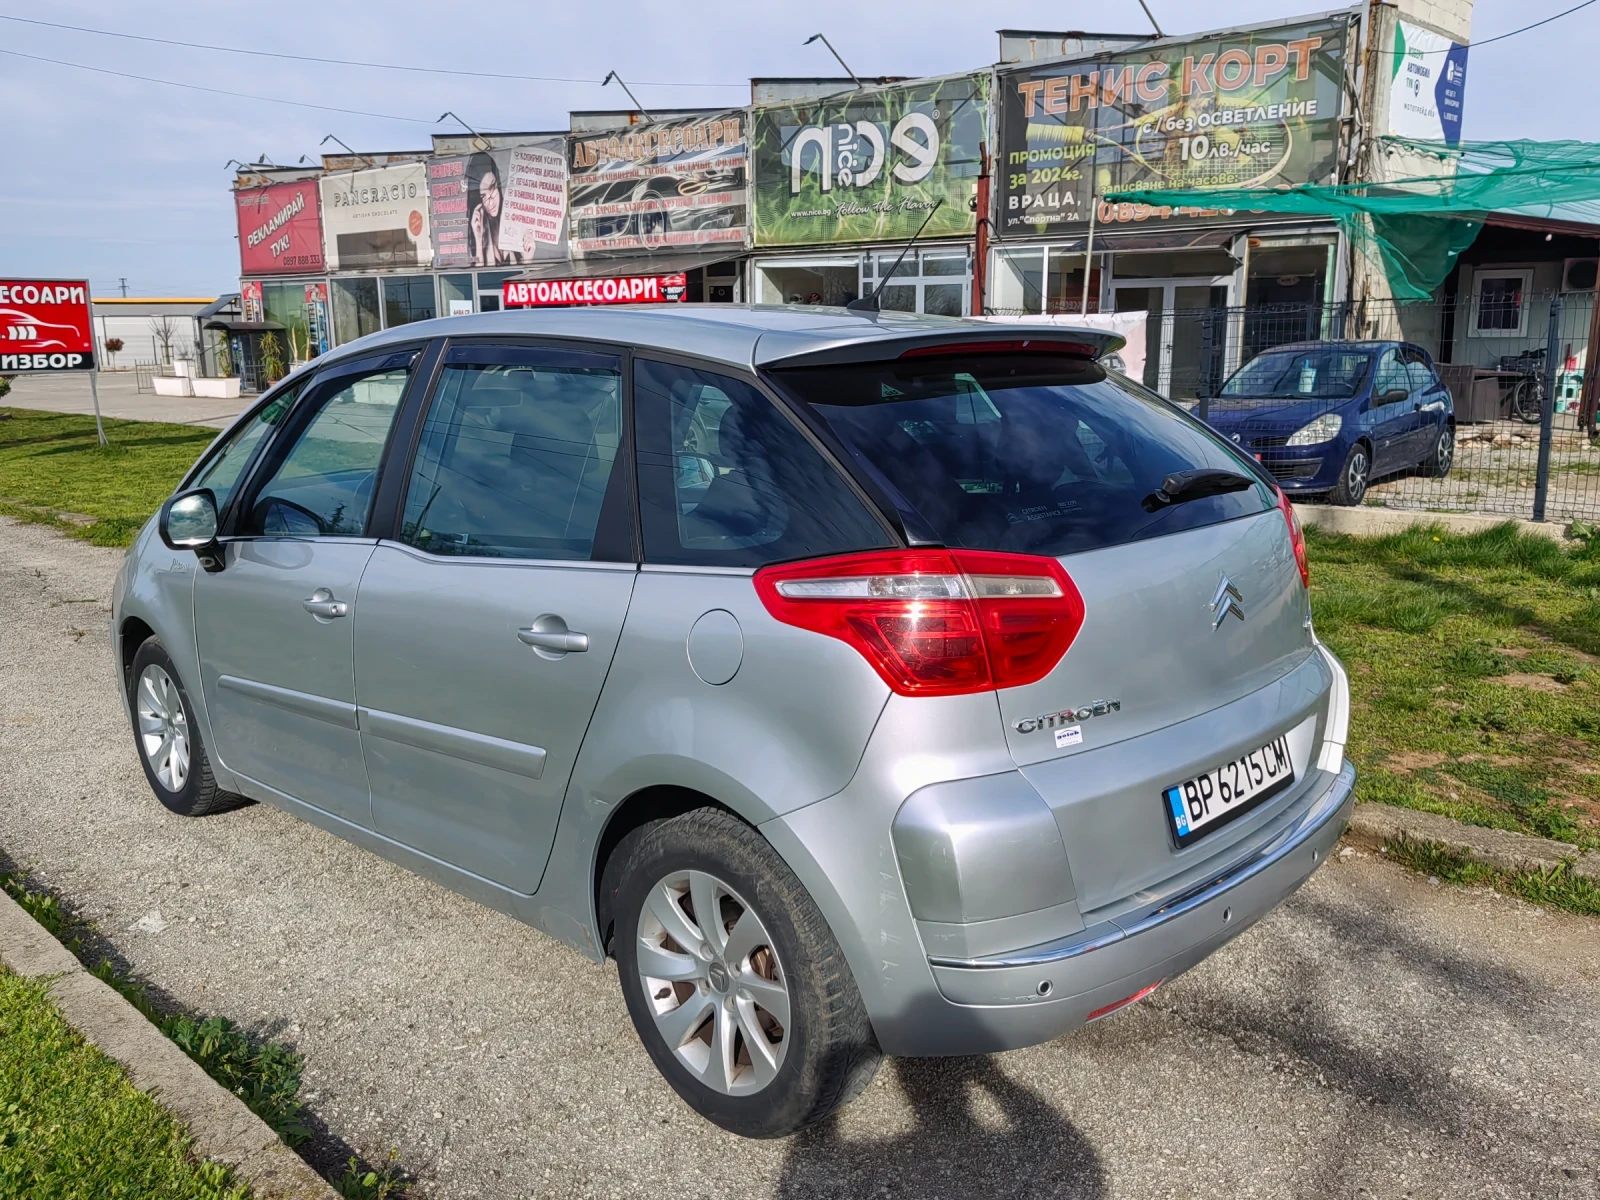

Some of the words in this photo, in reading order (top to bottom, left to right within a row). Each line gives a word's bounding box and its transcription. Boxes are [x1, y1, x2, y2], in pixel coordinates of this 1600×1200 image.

[1018, 61, 1168, 118] ТЕНИС
[1181, 36, 1322, 97] КОРТ
[1197, 100, 1318, 127] ОСВЕТЛЕНИЕ
[573, 117, 741, 168] АВТОАКСЕСОАРИ
[1009, 143, 1097, 165] ПРОМОЦИЯ
[1031, 166, 1084, 184] 2024г.
[333, 182, 418, 208] PANCRACIO
[1008, 191, 1083, 210] ВРАЦА,
[1101, 181, 1166, 195] записване
[247, 190, 306, 249] РЕКЛАМИРАЙ
[270, 234, 290, 258] ТУК!
[507, 277, 658, 303] АВТОАКСЕСОАРИ
[1, 353, 83, 370] ИЗБОР
[1217, 750, 1264, 804] 6215
[1175, 814, 1187, 829] BG
